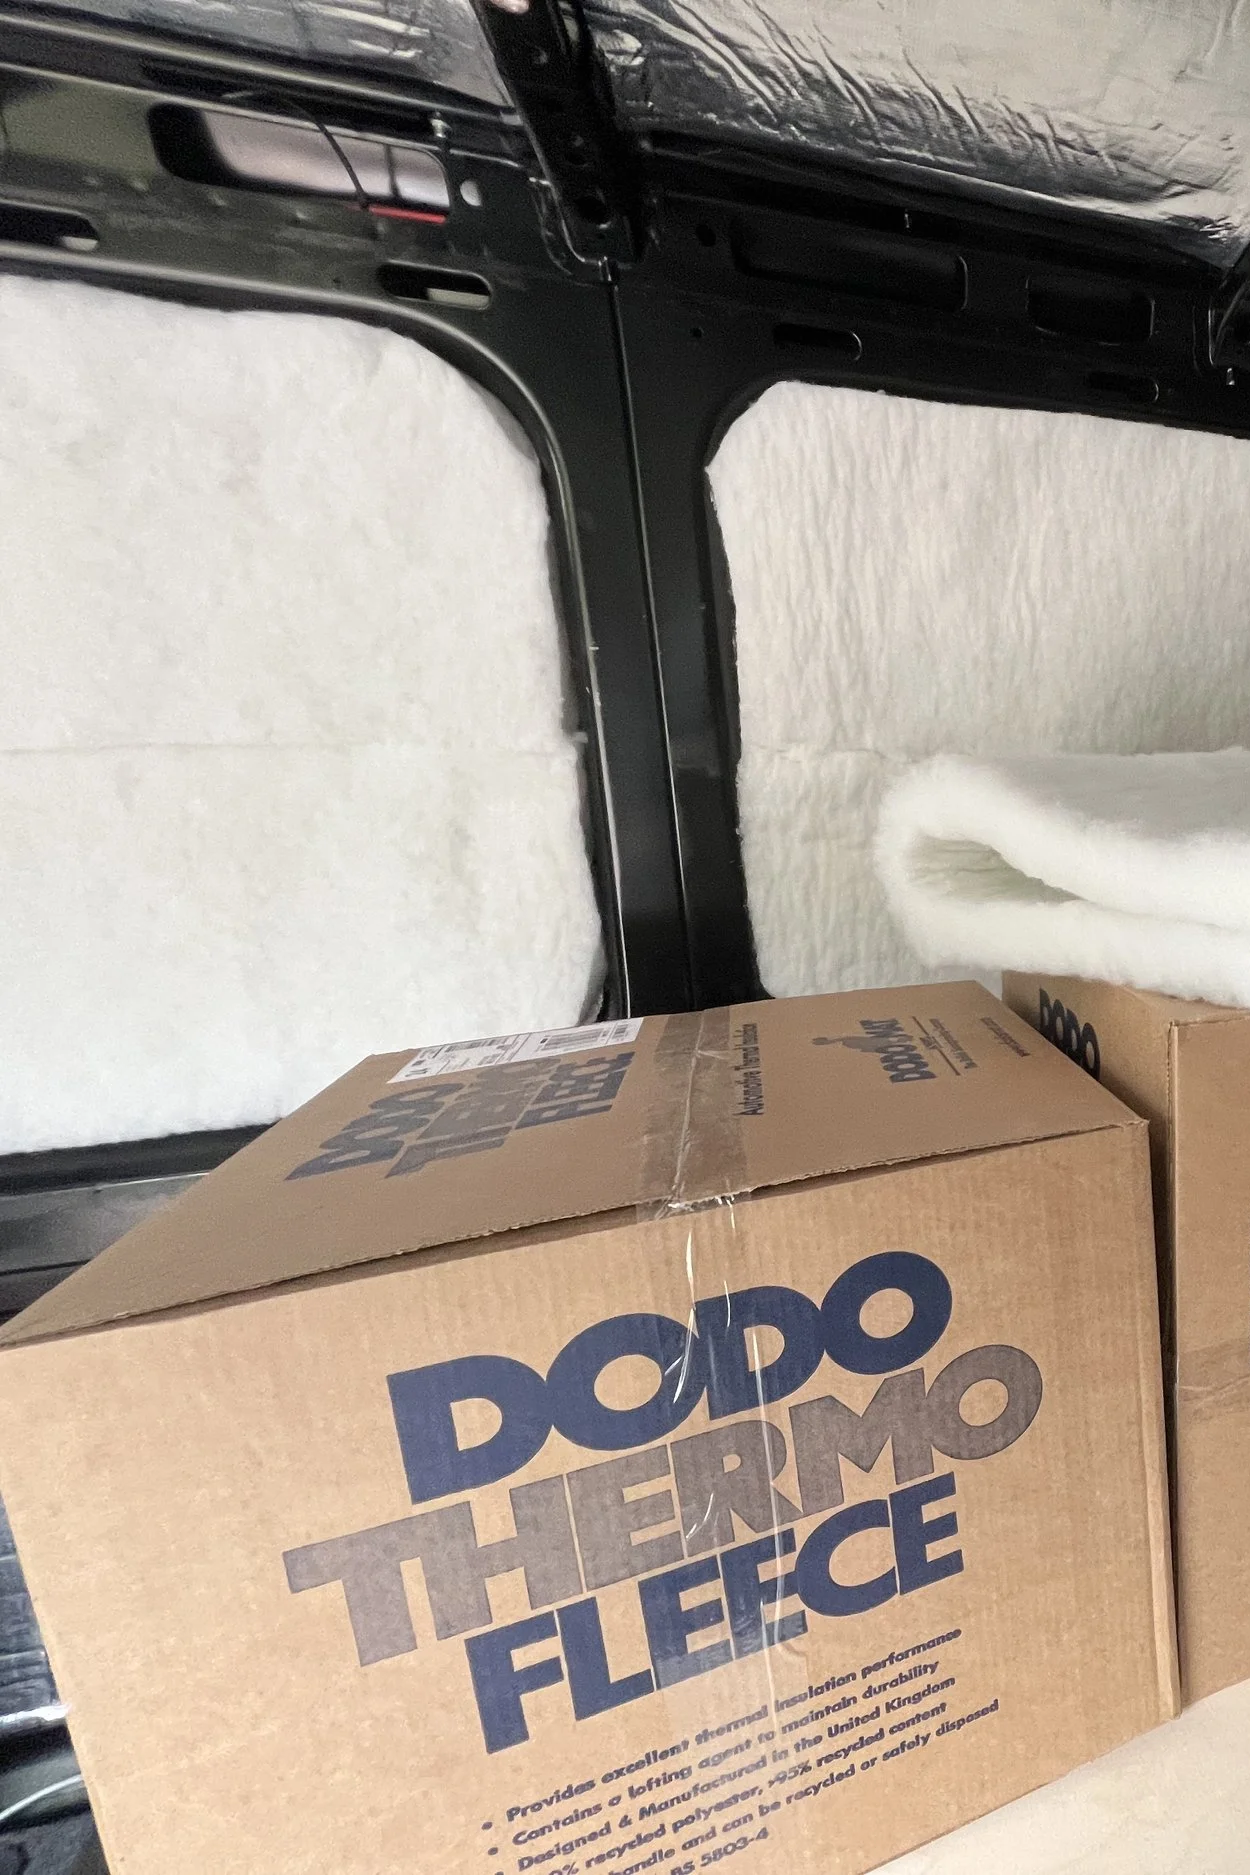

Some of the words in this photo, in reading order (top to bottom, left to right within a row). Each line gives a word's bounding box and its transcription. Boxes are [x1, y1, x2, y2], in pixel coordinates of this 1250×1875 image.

[738, 1073, 765, 1116] Automotive
[880, 1044, 937, 1083] DODO
[1039, 987, 1101, 1080] DODO
[284, 1083, 465, 1181] DODO
[386, 1251, 953, 1505] DODO
[283, 1344, 1043, 1668] THERMO
[464, 1472, 964, 1754] FLEECE
[506, 1779, 597, 1822] Provides
[601, 1740, 690, 1784] excellent
[695, 1705, 769, 1745] thermal
[775, 1672, 857, 1712] insulation
[861, 1628, 962, 1679] performance
[512, 1803, 603, 1846] Contains
[608, 1794, 622, 1807] a
[628, 1766, 692, 1800] lofting
[698, 1739, 753, 1770] agent
[757, 1730, 775, 1744] to
[782, 1695, 858, 1734] maintain
[862, 1661, 939, 1699] durability
[517, 1821, 612, 1872] Designed
[618, 1814, 633, 1829] &
[639, 1755, 768, 1821] Manufactured
[772, 1749, 789, 1763] in
[793, 1734, 823, 1753] the
[827, 1706, 881, 1738] United
[885, 1677, 956, 1714] Kingdom
[585, 1824, 667, 1868] recycled
[672, 1786, 764, 1834] polyester,
[816, 1728, 885, 1767] recycled
[889, 1702, 947, 1736] content
[682, 1826, 717, 1851] and
[722, 1812, 754, 1833] can
[758, 1800, 781, 1817] be
[786, 1763, 856, 1804] recycled
[860, 1757, 878, 1772] or
[882, 1732, 931, 1762] safely
[935, 1699, 999, 1737] disposed
[670, 1860, 696, 1875] BS
[701, 1827, 769, 1867] 5803-4
